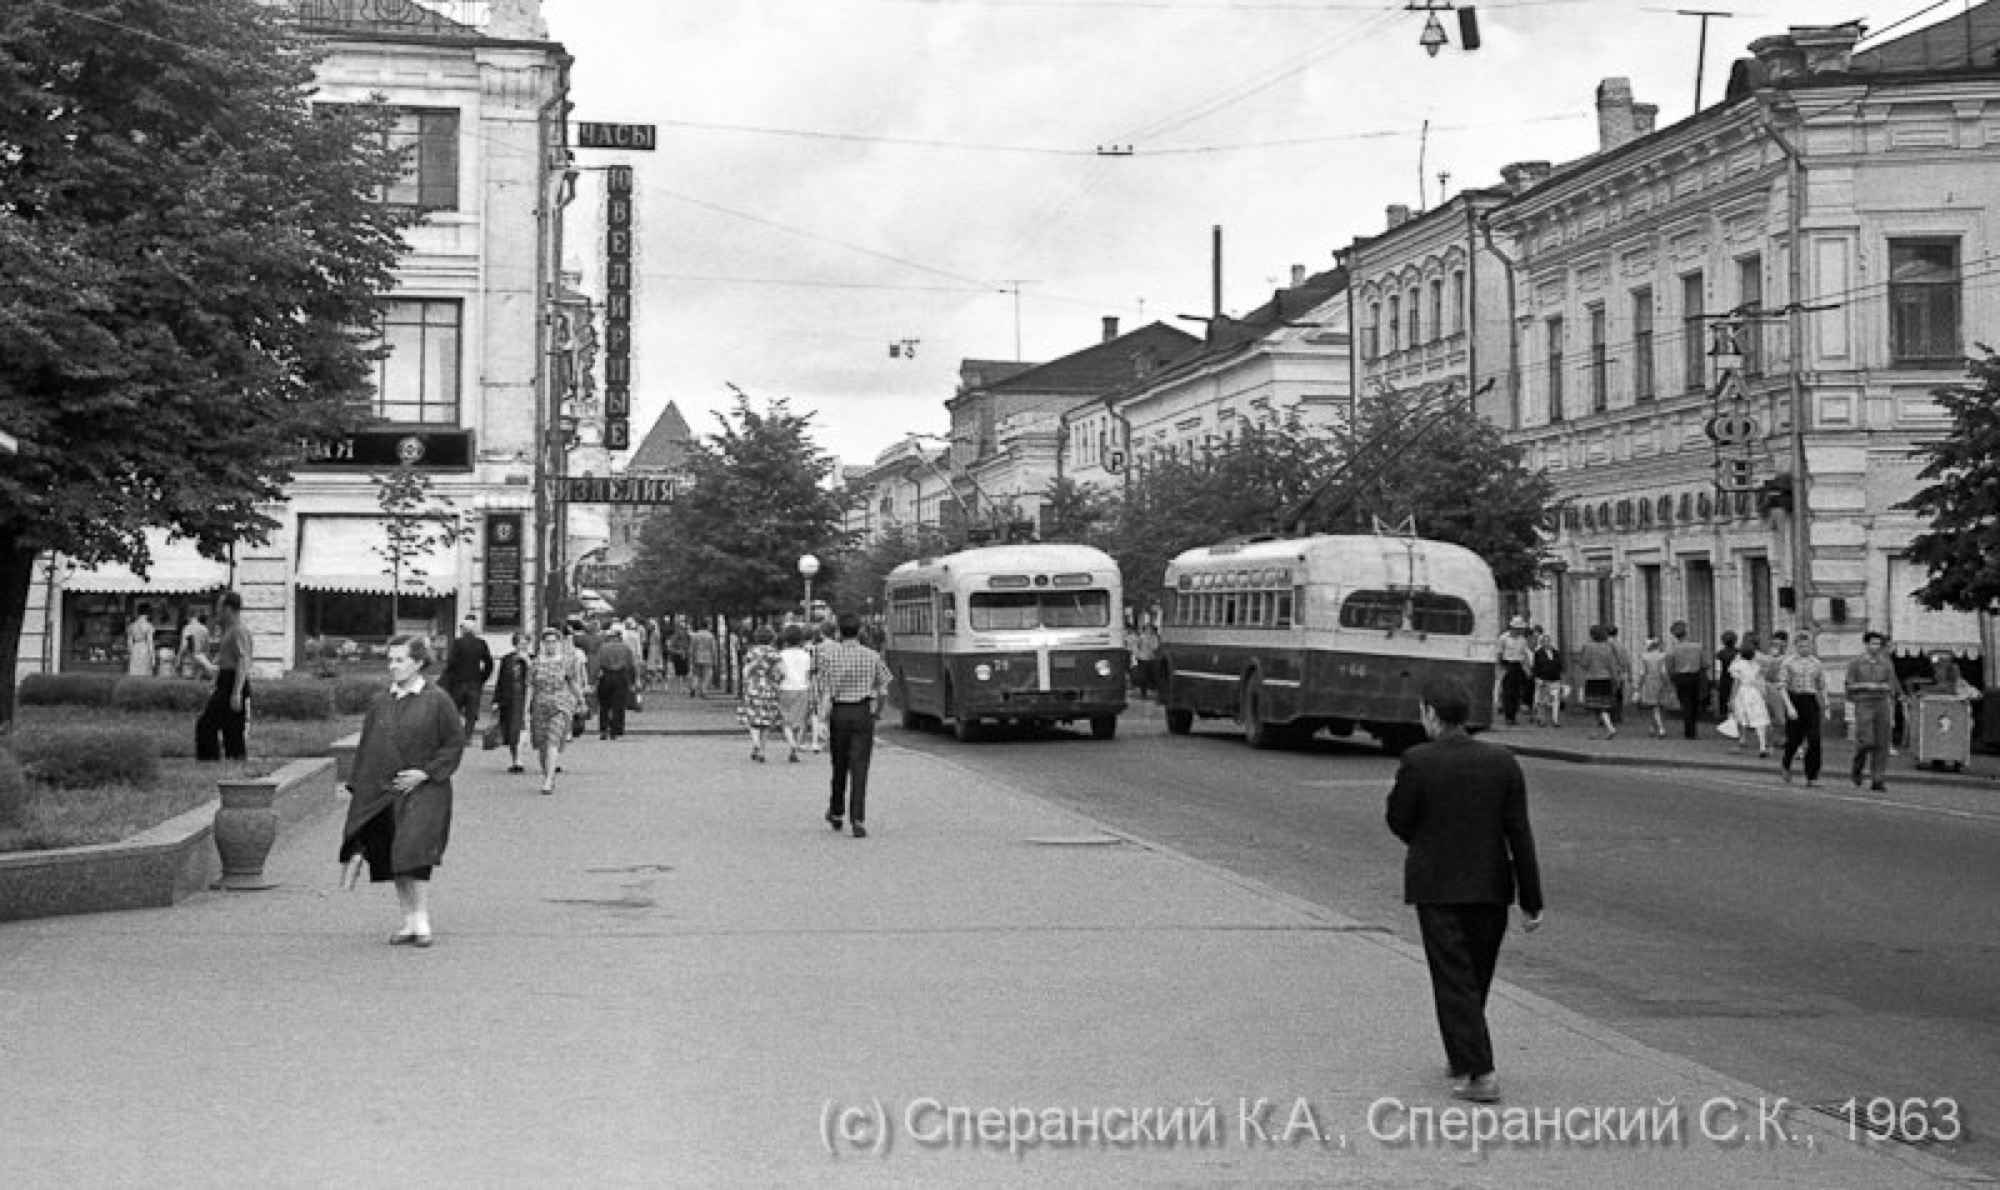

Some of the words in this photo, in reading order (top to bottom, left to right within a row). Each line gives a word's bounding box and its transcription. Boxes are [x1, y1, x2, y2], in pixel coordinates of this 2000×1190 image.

[581, 123, 652, 146] ЧАСЫ
[608, 168, 631, 446] ЮВЕЛИРНЫЕ
[1706, 323, 1758, 491] КАФЕ
[559, 479, 673, 501] ИЗДЕЛИЯ
